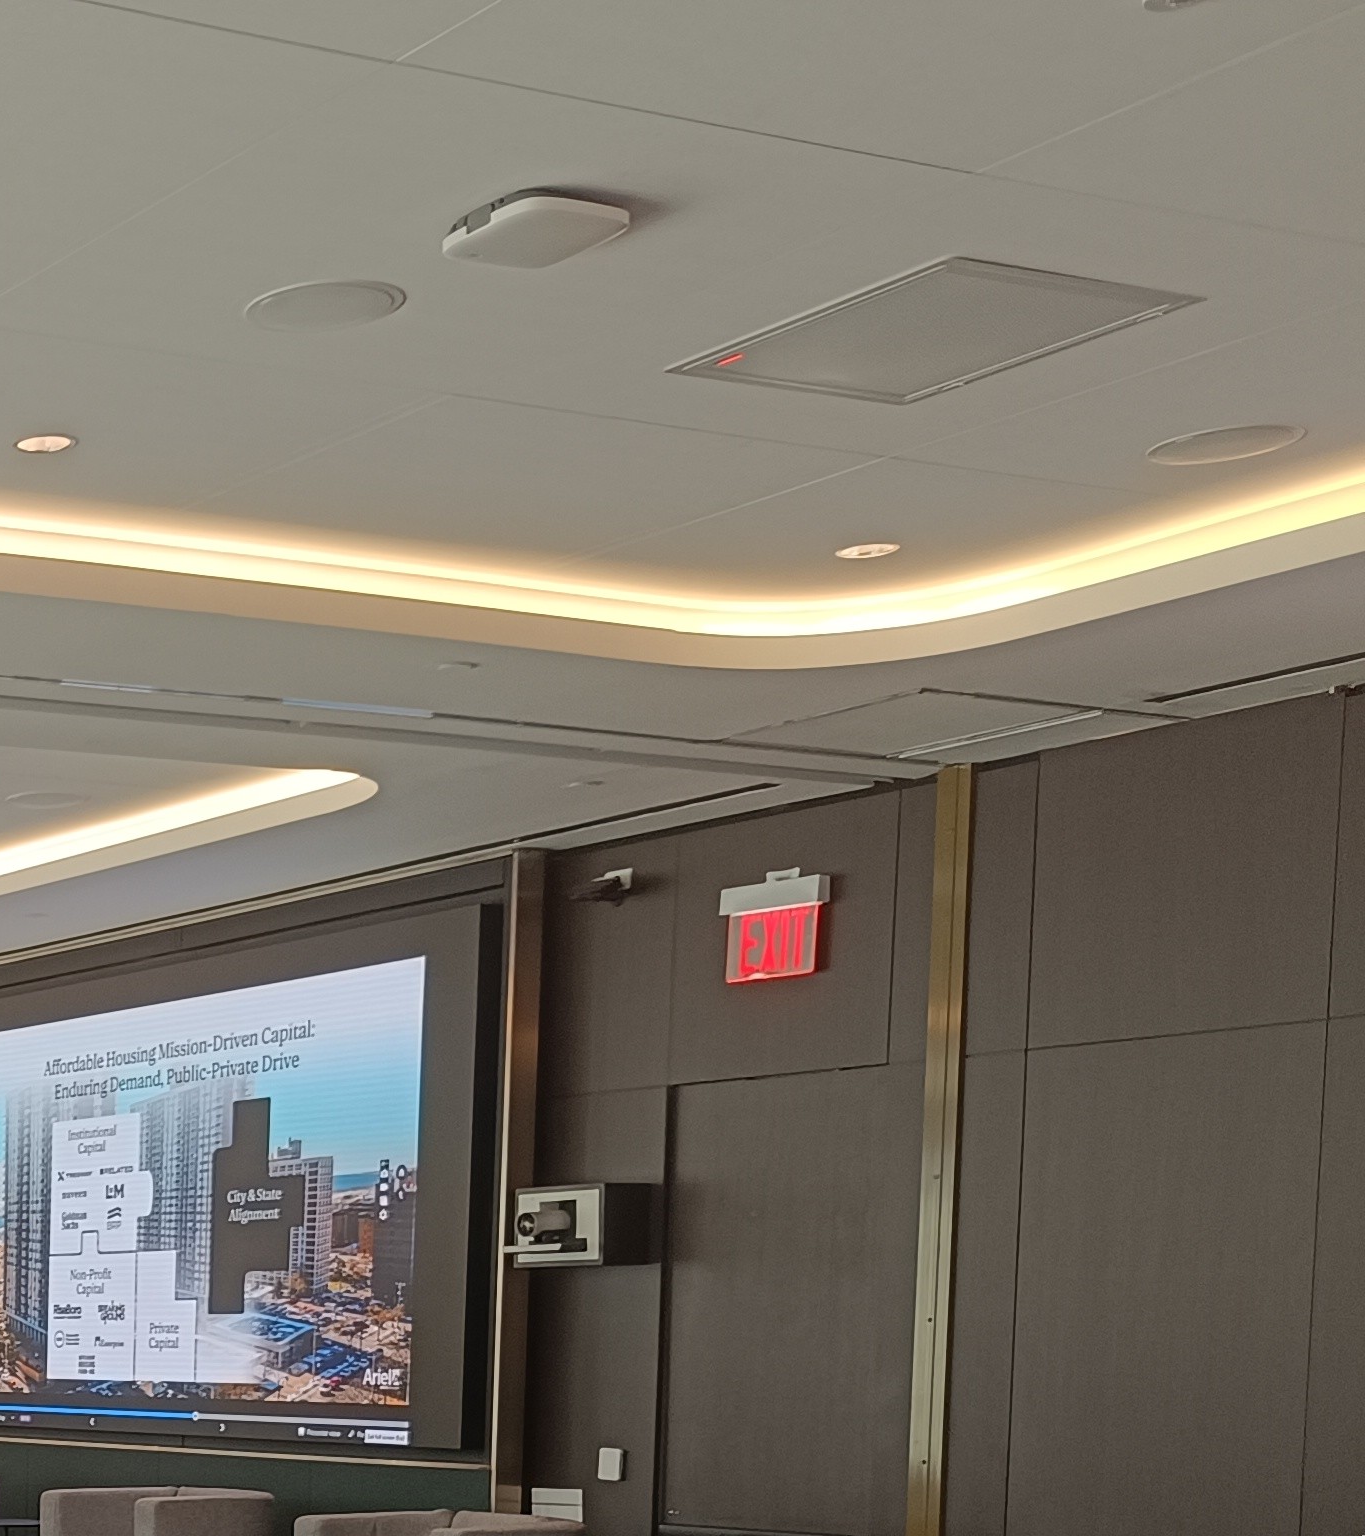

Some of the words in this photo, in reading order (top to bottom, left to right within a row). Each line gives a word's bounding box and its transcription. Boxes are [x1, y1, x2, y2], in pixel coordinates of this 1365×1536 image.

[740, 907, 810, 975] EXIT
[44, 1052, 104, 1076] Affordable
[106, 1047, 157, 1066] Housing
[158, 1028, 258, 1060] Mission-Driven
[261, 1020, 316, 1047] Capital:
[54, 1077, 108, 1099] Enduring
[110, 1069, 164, 1091] Demand,
[166, 1058, 259, 1085] Public-Private
[261, 1052, 300, 1073] Drive
[78, 1140, 106, 1156] Capital
[227, 1189, 247, 1205] City
[247, 1189, 256, 1202] &
[256, 1188, 282, 1202] State
[228, 1208, 281, 1224] Alignment
[70, 1267, 112, 1281] Non-Profit
[76, 1283, 105, 1297] Capital
[149, 1322, 179, 1334] Private
[149, 1337, 179, 1351] Capital
[362, 1368, 392, 1386] Ariel
